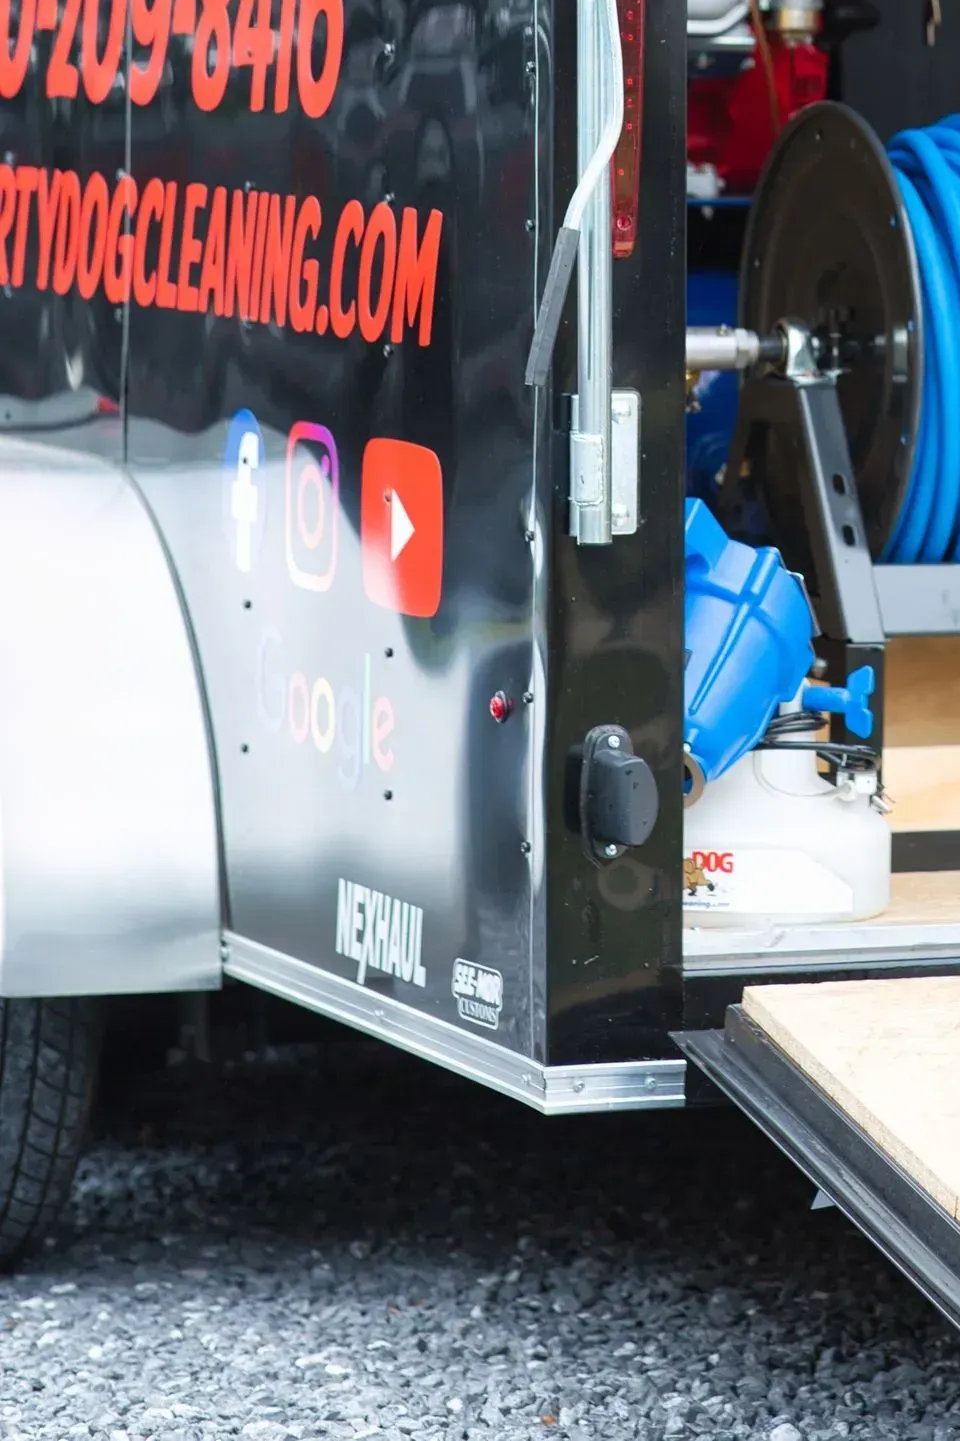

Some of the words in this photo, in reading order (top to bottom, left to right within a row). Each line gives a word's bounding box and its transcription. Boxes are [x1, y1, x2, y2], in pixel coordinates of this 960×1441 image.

[254, 623, 396, 792] Google
[691, 851, 734, 873] DOG
[335, 877, 427, 988] NEXHAUL
